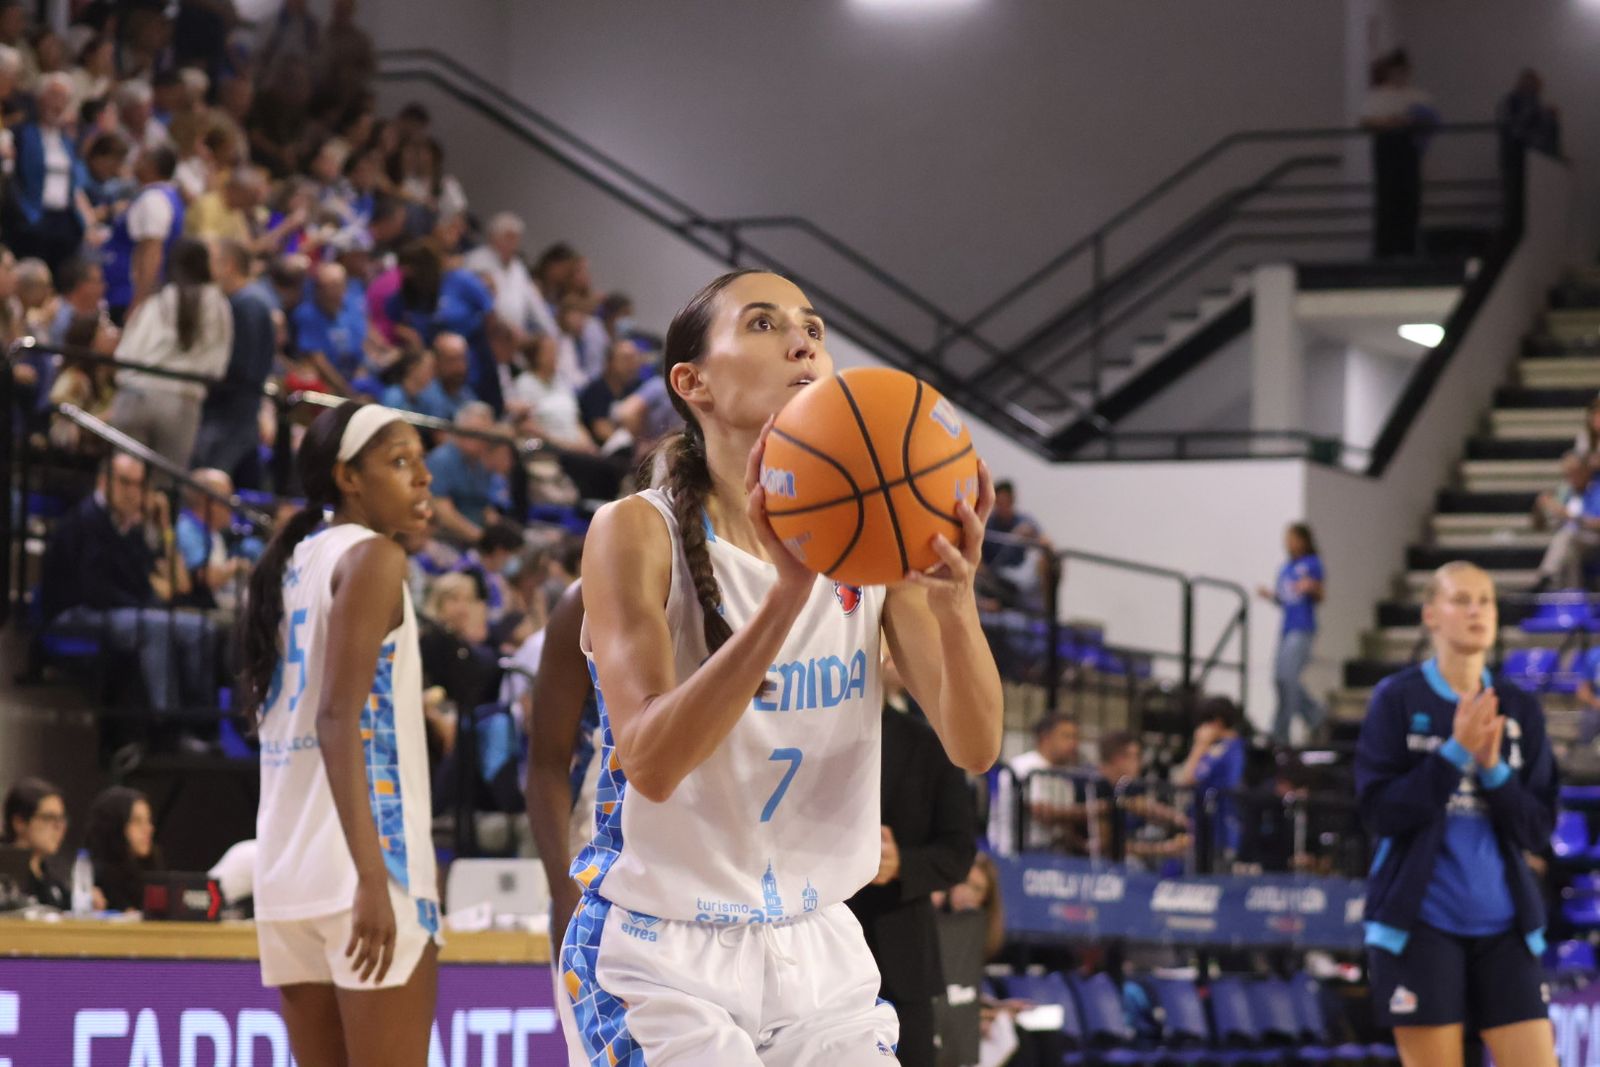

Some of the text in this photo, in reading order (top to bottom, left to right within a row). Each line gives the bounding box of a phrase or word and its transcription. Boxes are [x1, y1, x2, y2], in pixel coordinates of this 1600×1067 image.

[752, 648, 867, 712] ENIDA
[759, 747, 803, 823] 7
[696, 896, 749, 914] turismo
[620, 921, 658, 943] errea
